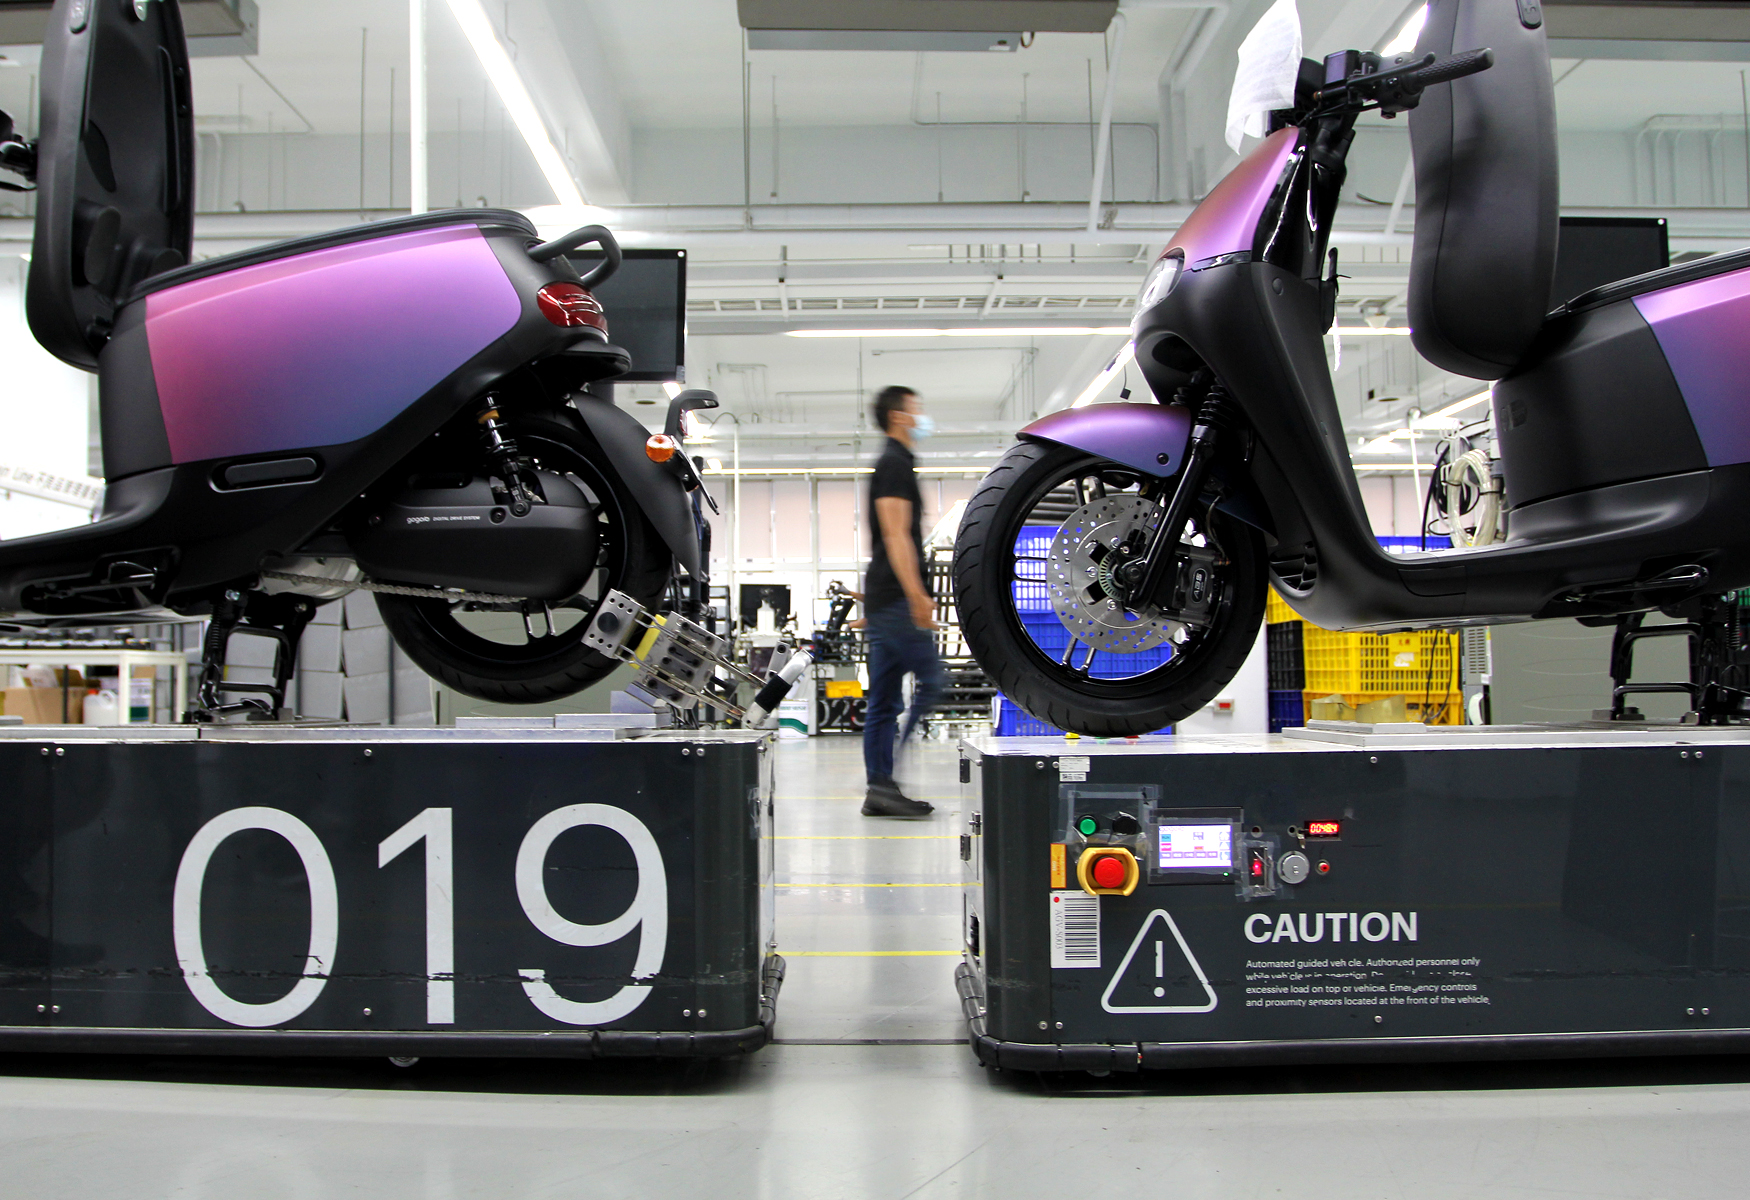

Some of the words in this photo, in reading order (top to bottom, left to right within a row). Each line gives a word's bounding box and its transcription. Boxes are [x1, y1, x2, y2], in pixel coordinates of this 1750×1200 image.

[172, 803, 669, 1028] 019
[1244, 911, 1418, 944] CAUTION
[1246, 959, 1296, 968] Automated
[1297, 959, 1329, 970] guided
[1330, 958, 1364, 967] vehcle.
[1416, 958, 1460, 967] personnel
[1461, 957, 1481, 967] only
[1245, 985, 1289, 994] excessive
[1290, 984, 1310, 994] load
[1325, 985, 1341, 995] top
[1440, 983, 1478, 992] controls
[1245, 998, 1263, 1007] and
[1265, 998, 1307, 1008] proximity
[1308, 998, 1343, 1007] sensors
[1344, 996, 1377, 1006] located
[1379, 997, 1388, 1005] at
[1390, 996, 1405, 1005] the
[1406, 995, 1428, 1005] front
[1429, 995, 1440, 1005] of
[1441, 995, 1456, 1004] the
